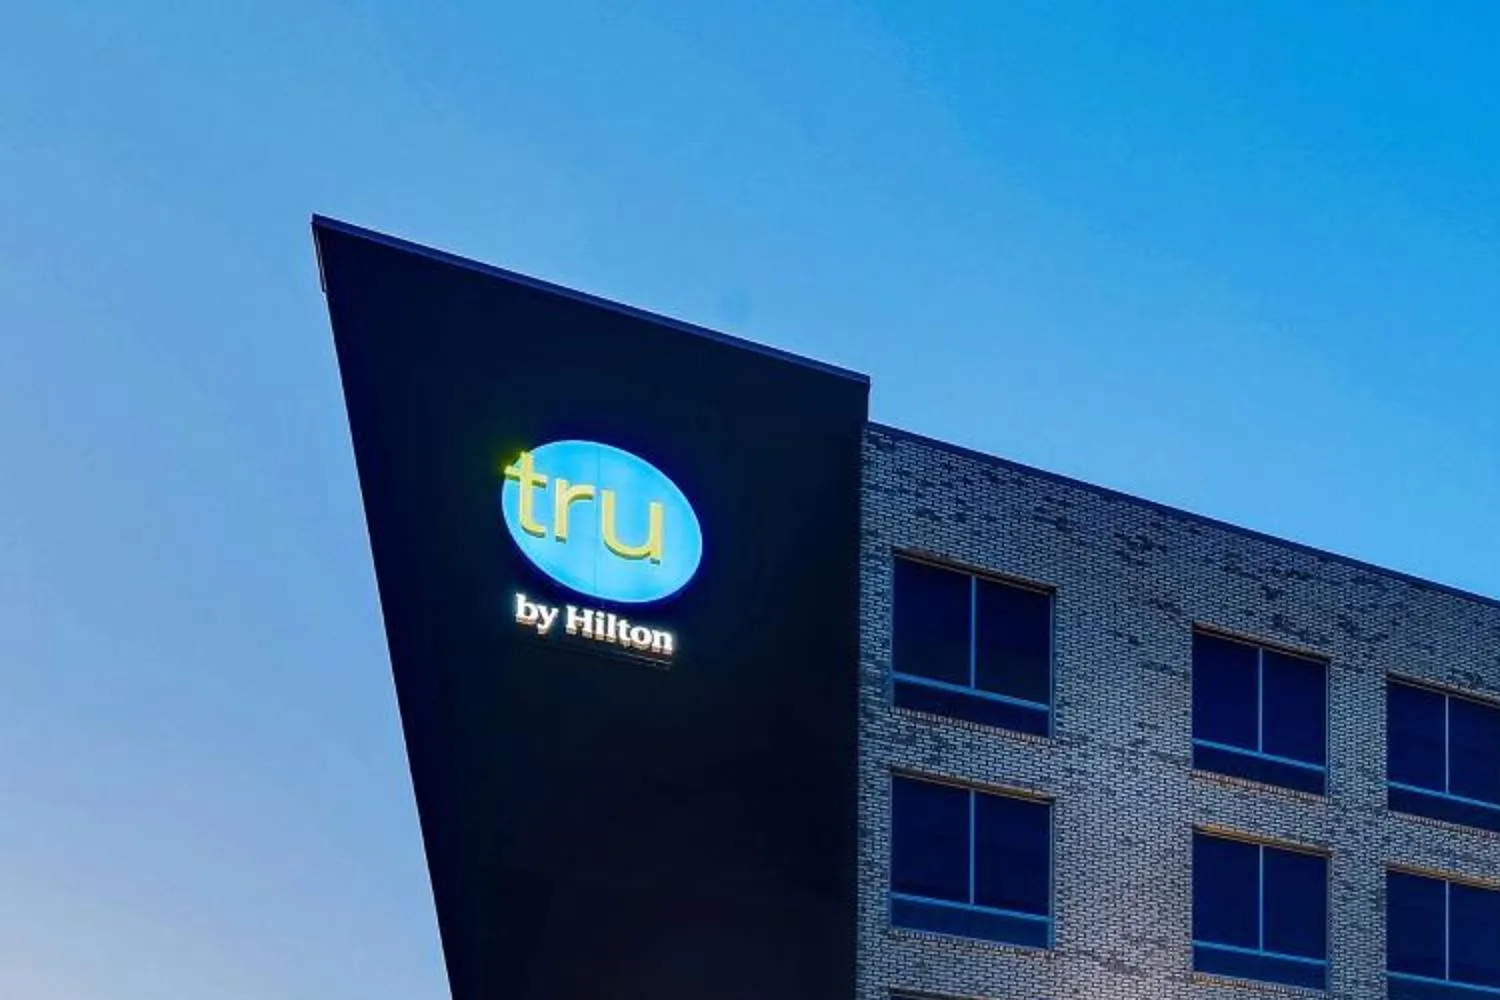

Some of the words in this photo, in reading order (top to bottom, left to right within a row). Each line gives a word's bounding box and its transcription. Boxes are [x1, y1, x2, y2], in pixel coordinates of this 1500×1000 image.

[503, 450, 664, 565] tru
[514, 593, 559, 634] by
[565, 604, 673, 654] Hilton
